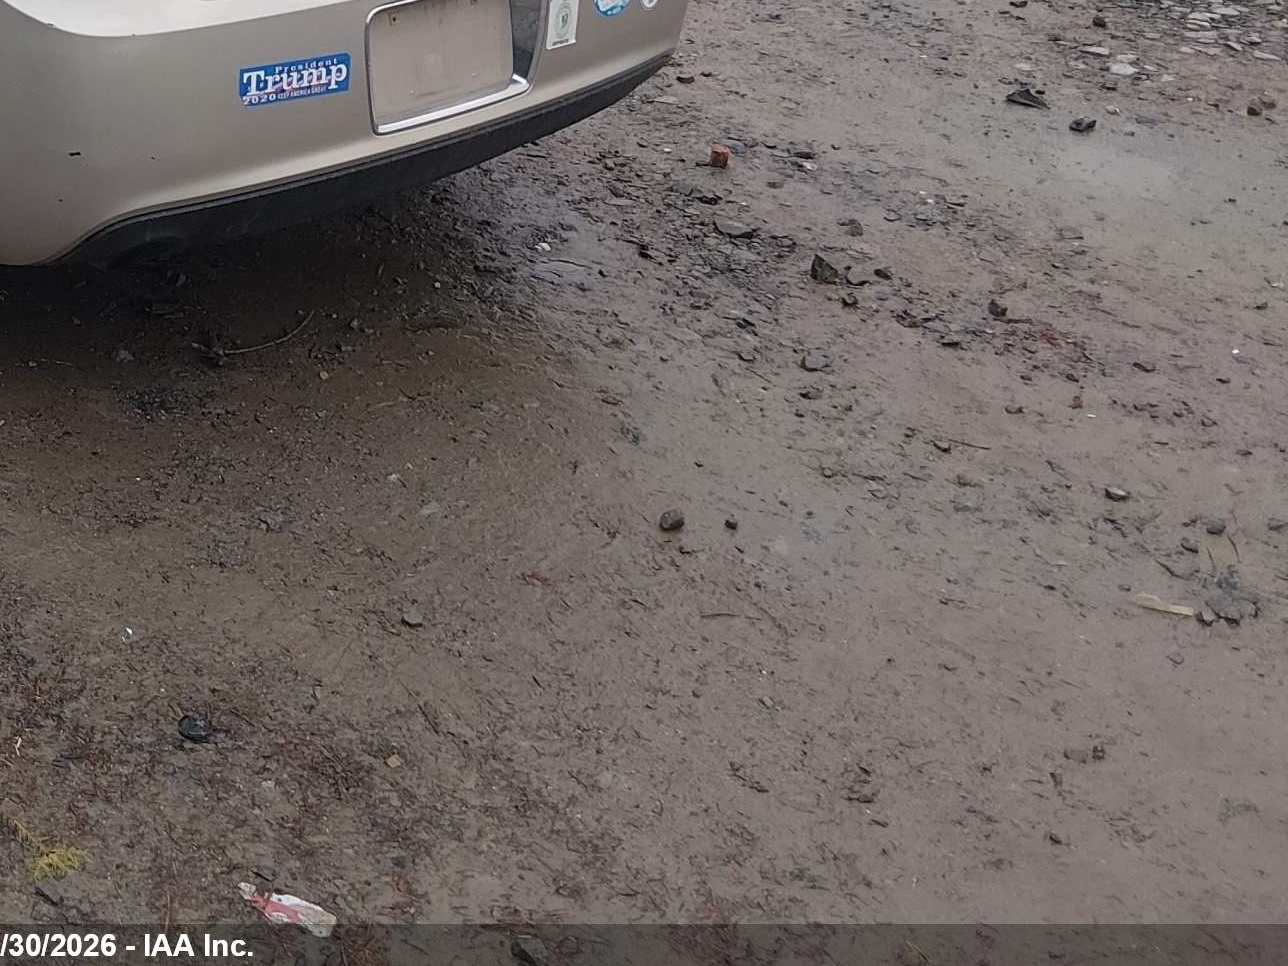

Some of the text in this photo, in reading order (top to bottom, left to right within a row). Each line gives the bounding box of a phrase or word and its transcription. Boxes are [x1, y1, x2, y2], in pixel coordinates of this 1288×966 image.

[275, 57, 338, 74] President
[243, 63, 347, 96] Trump
[242, 93, 276, 105] 2020
